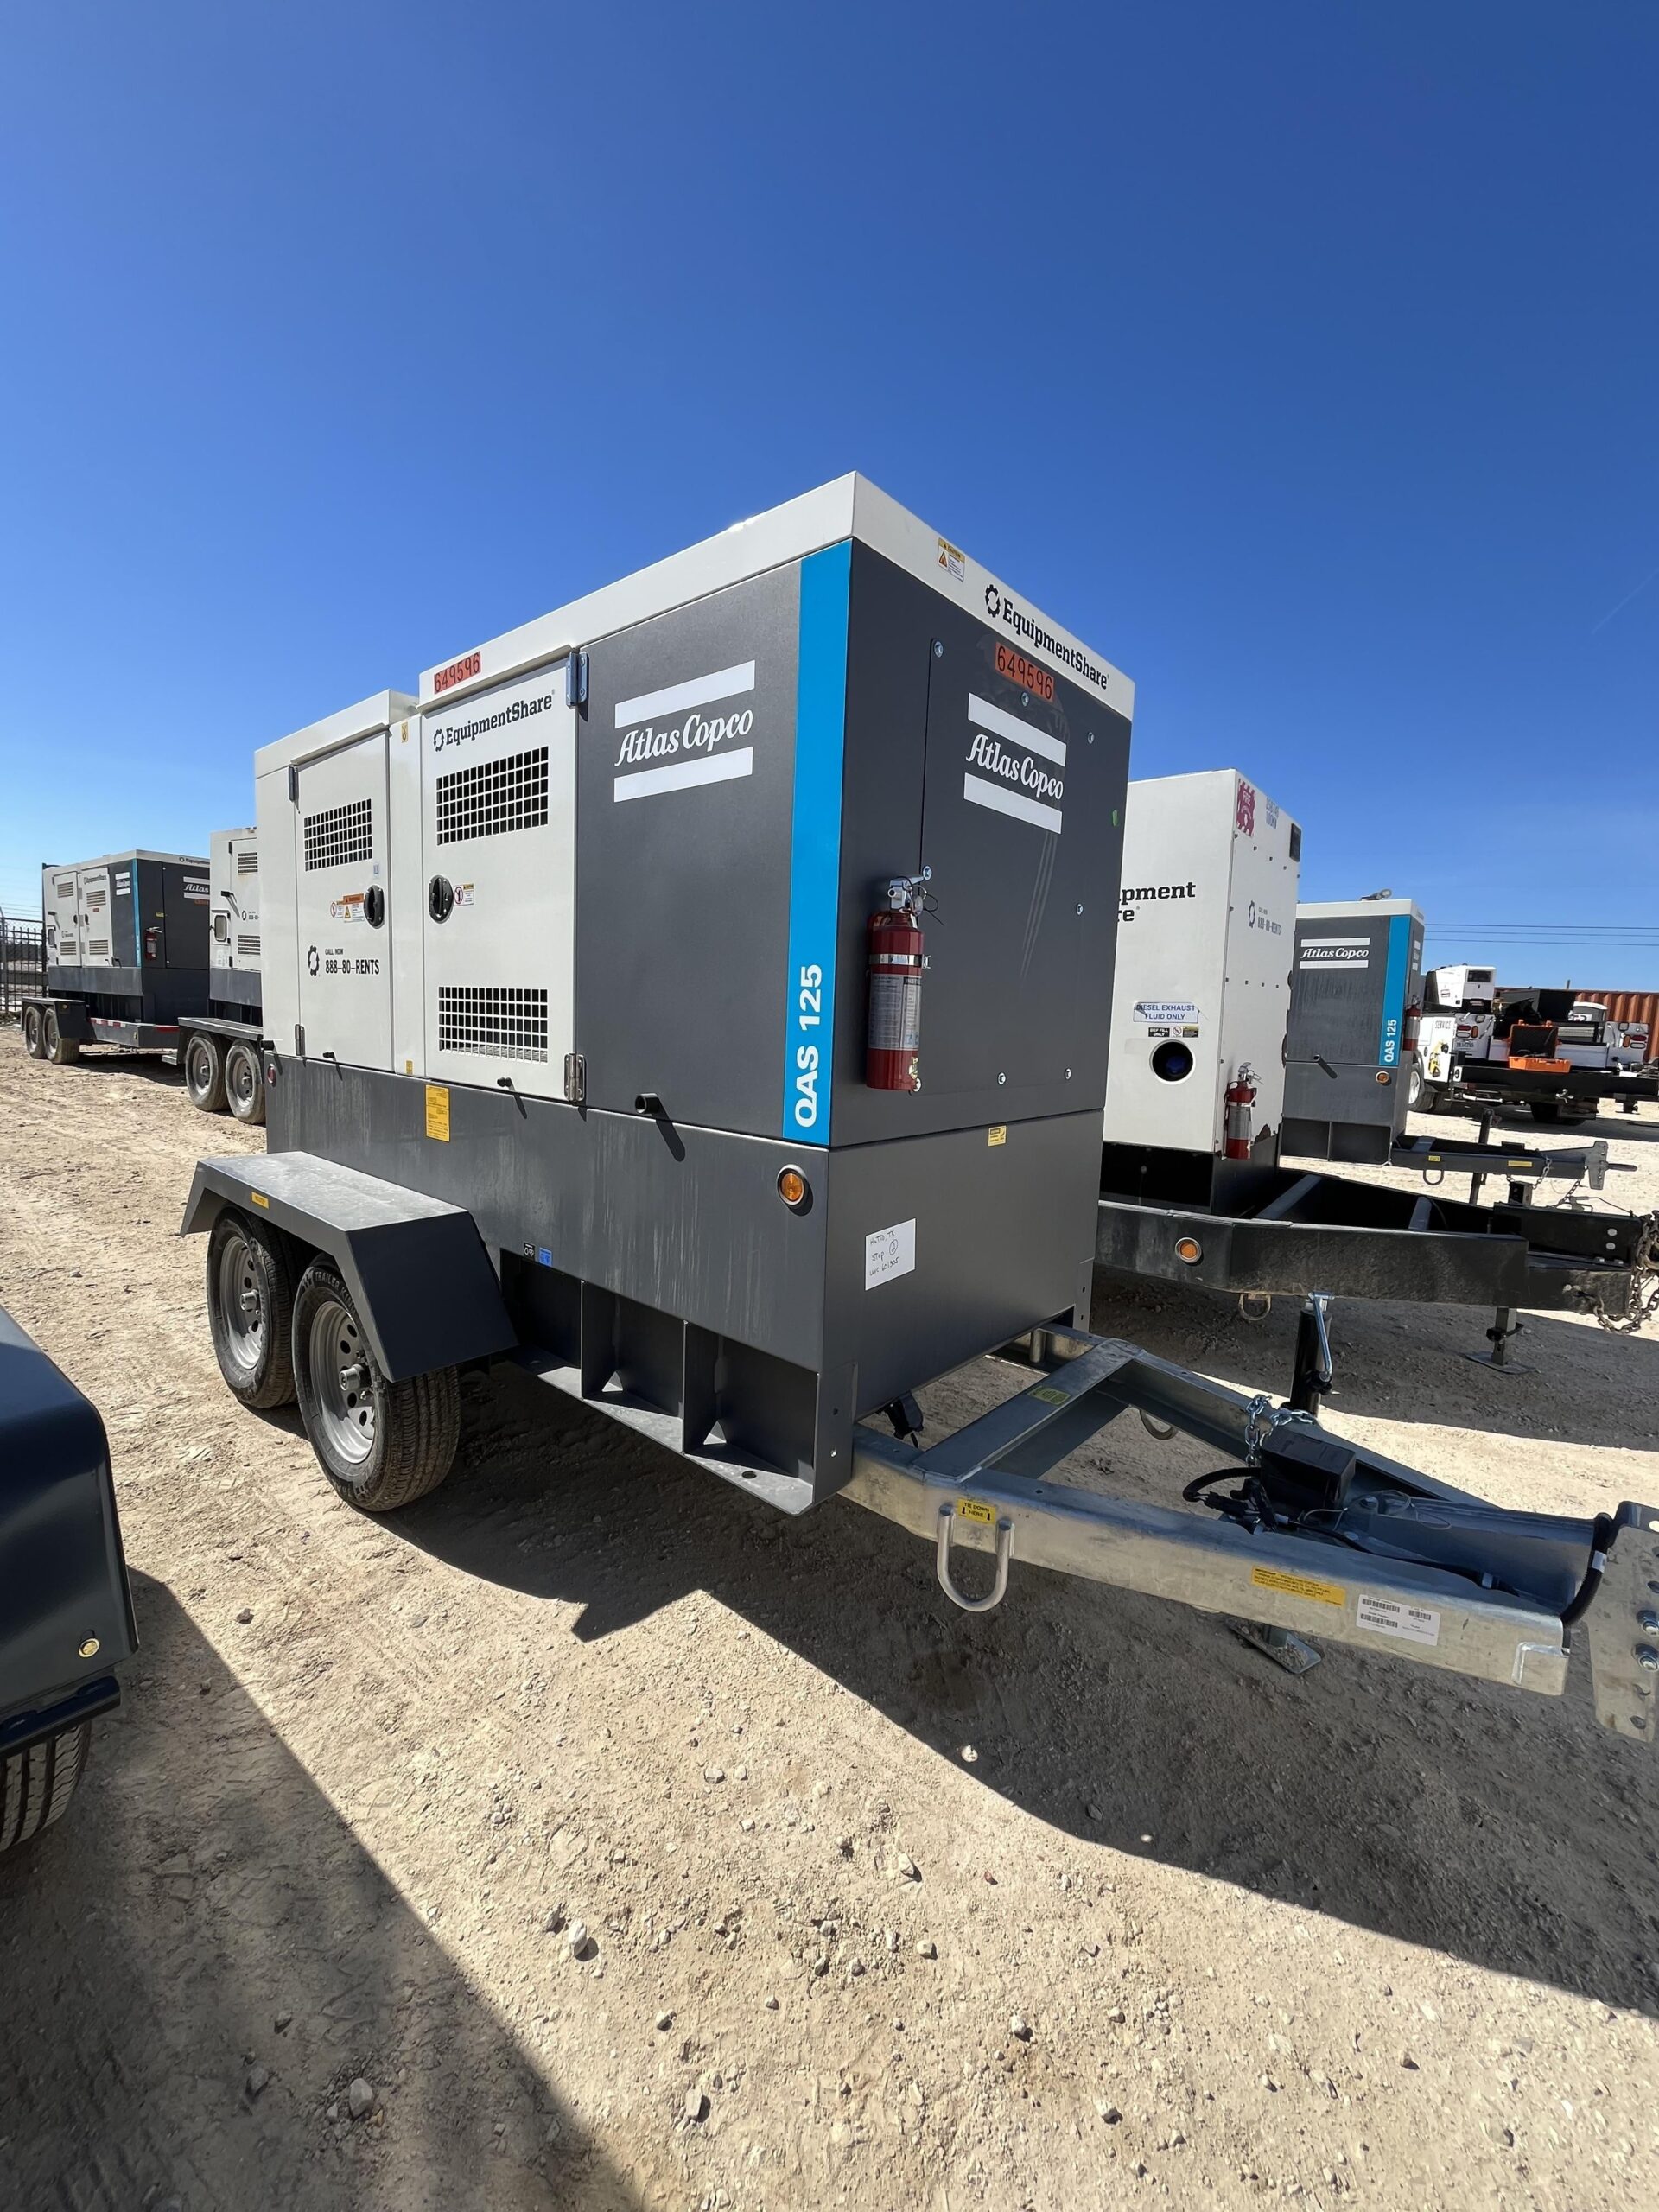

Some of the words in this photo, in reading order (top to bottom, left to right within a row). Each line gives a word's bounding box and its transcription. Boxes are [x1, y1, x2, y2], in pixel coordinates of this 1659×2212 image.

[1002, 598, 1108, 690] EquipmentShare
[434, 651, 481, 693] 649596
[997, 645, 1052, 700] 649596
[446, 694, 552, 746] EquipmentShare
[613, 727, 680, 767] Atlas
[682, 709, 754, 753] Copco
[965, 734, 1020, 781] Atlas
[1020, 756, 1064, 800] Copco
[1119, 882, 1196, 906] pment
[325, 959, 379, 975] 888-80-RENTS
[1300, 948, 1334, 959] Atlas
[1335, 947, 1369, 960] Copco
[798, 964, 823, 1031] 125
[1384, 1040, 1395, 1063] QAS
[1387, 1020, 1397, 1037] 125
[794, 1046, 819, 1128] QAS
